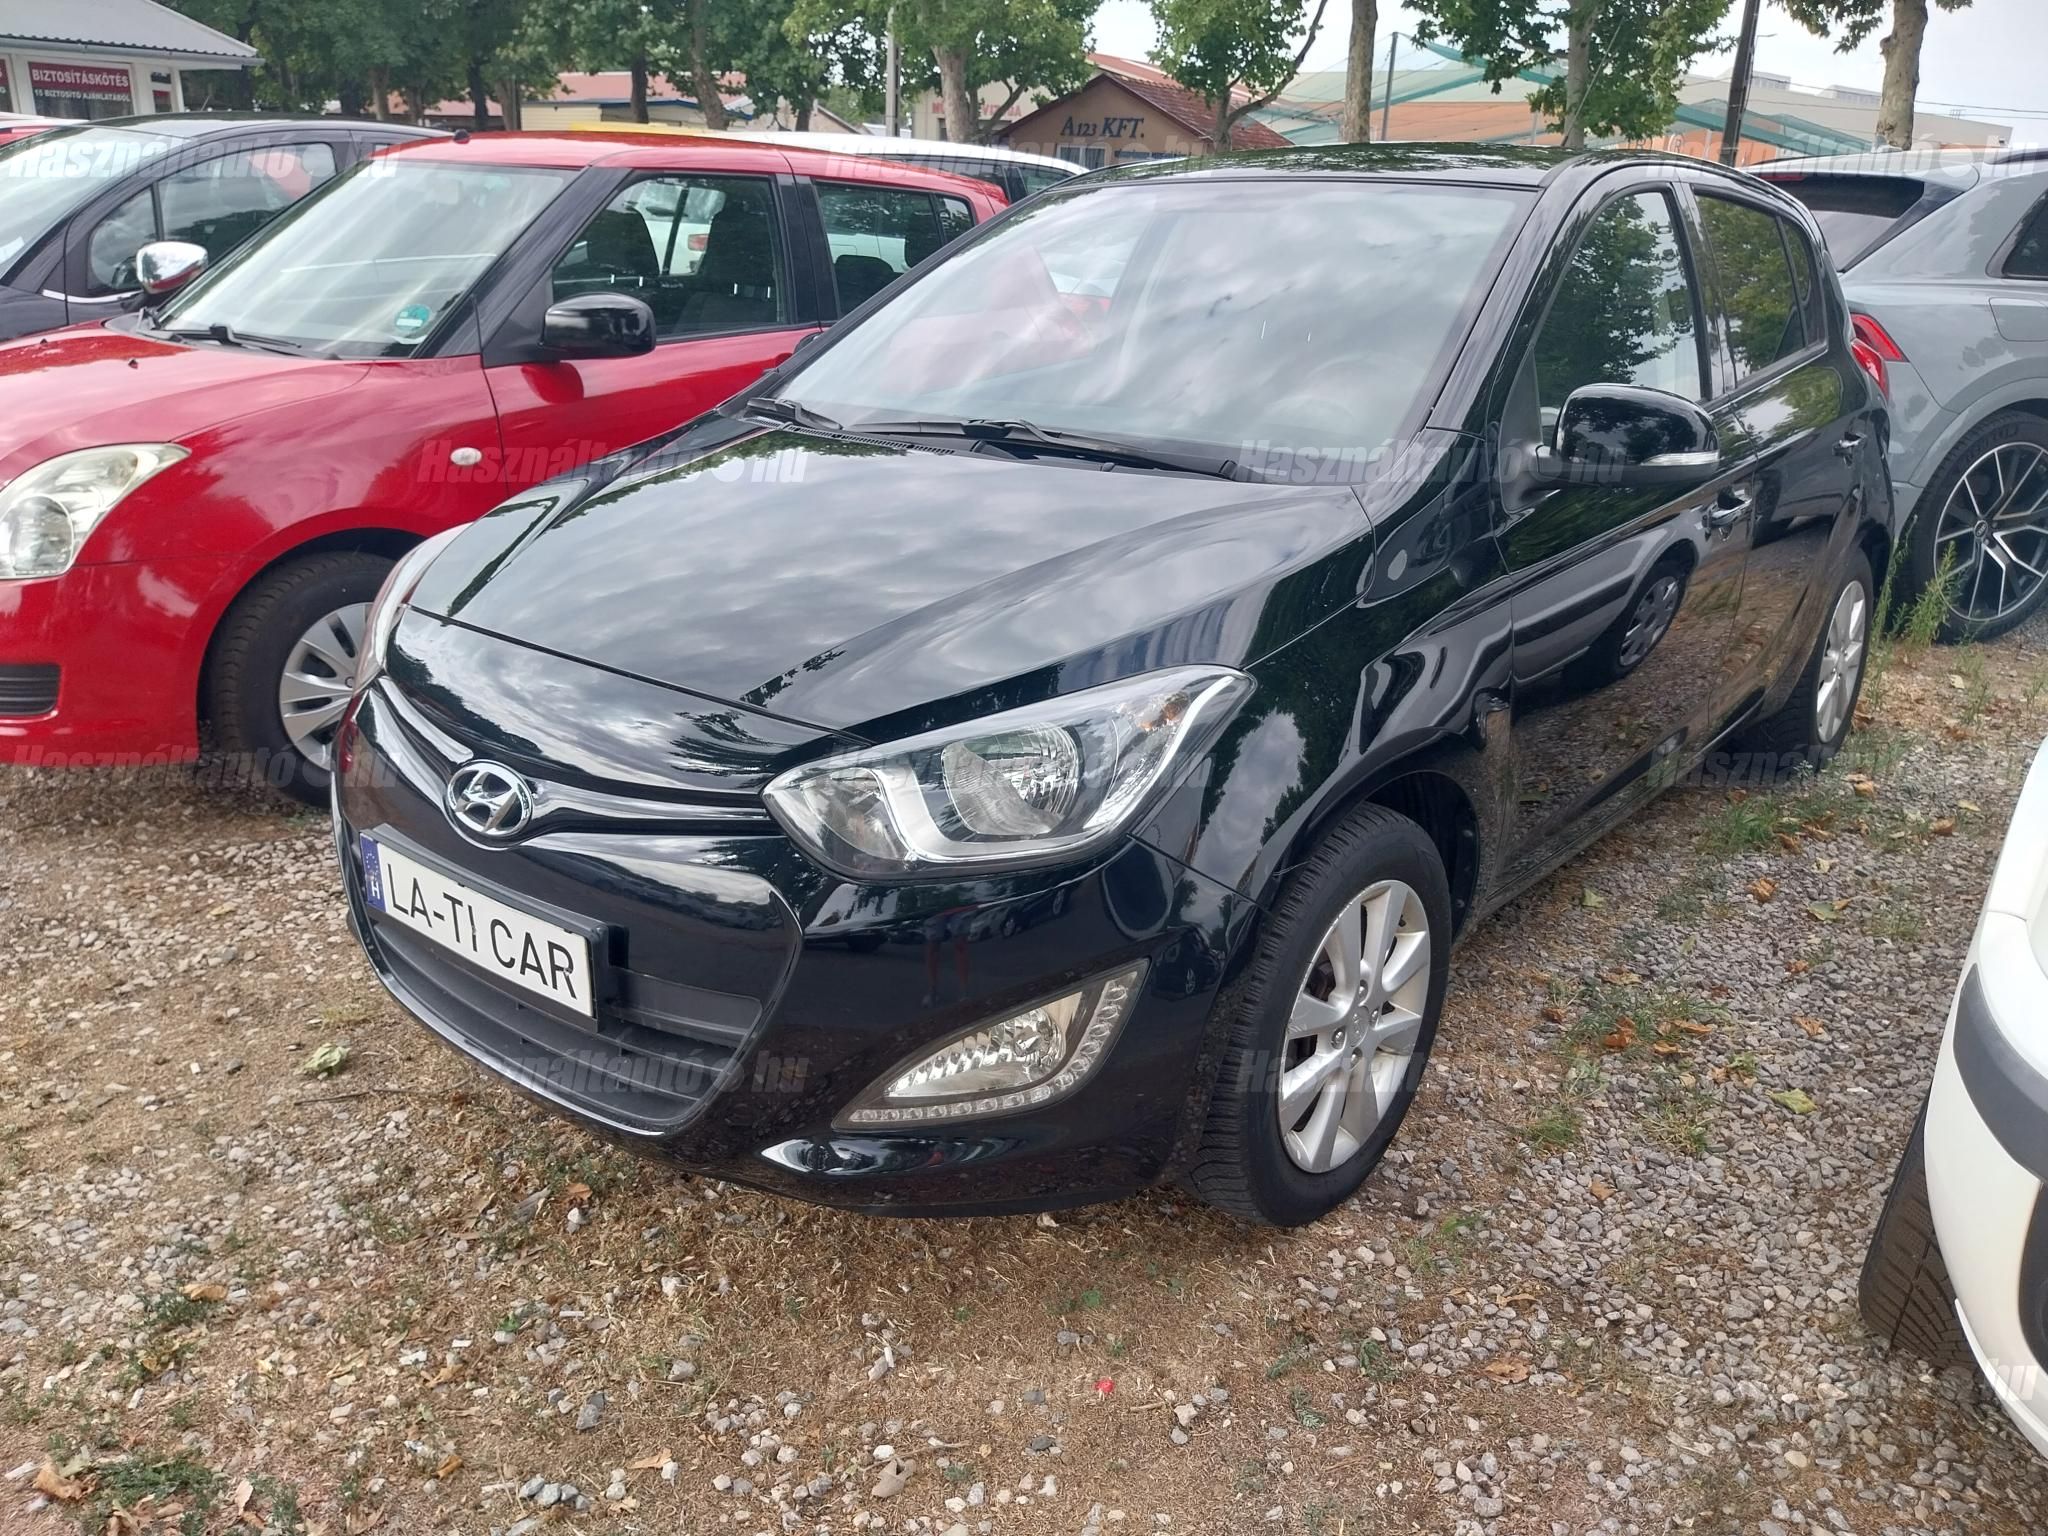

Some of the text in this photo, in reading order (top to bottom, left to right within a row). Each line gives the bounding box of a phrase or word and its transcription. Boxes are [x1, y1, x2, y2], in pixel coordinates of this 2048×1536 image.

[1100, 117, 1145, 138] KFT.
[371, 880, 381, 900] H
[387, 863, 578, 1000] LA-TI CAR
